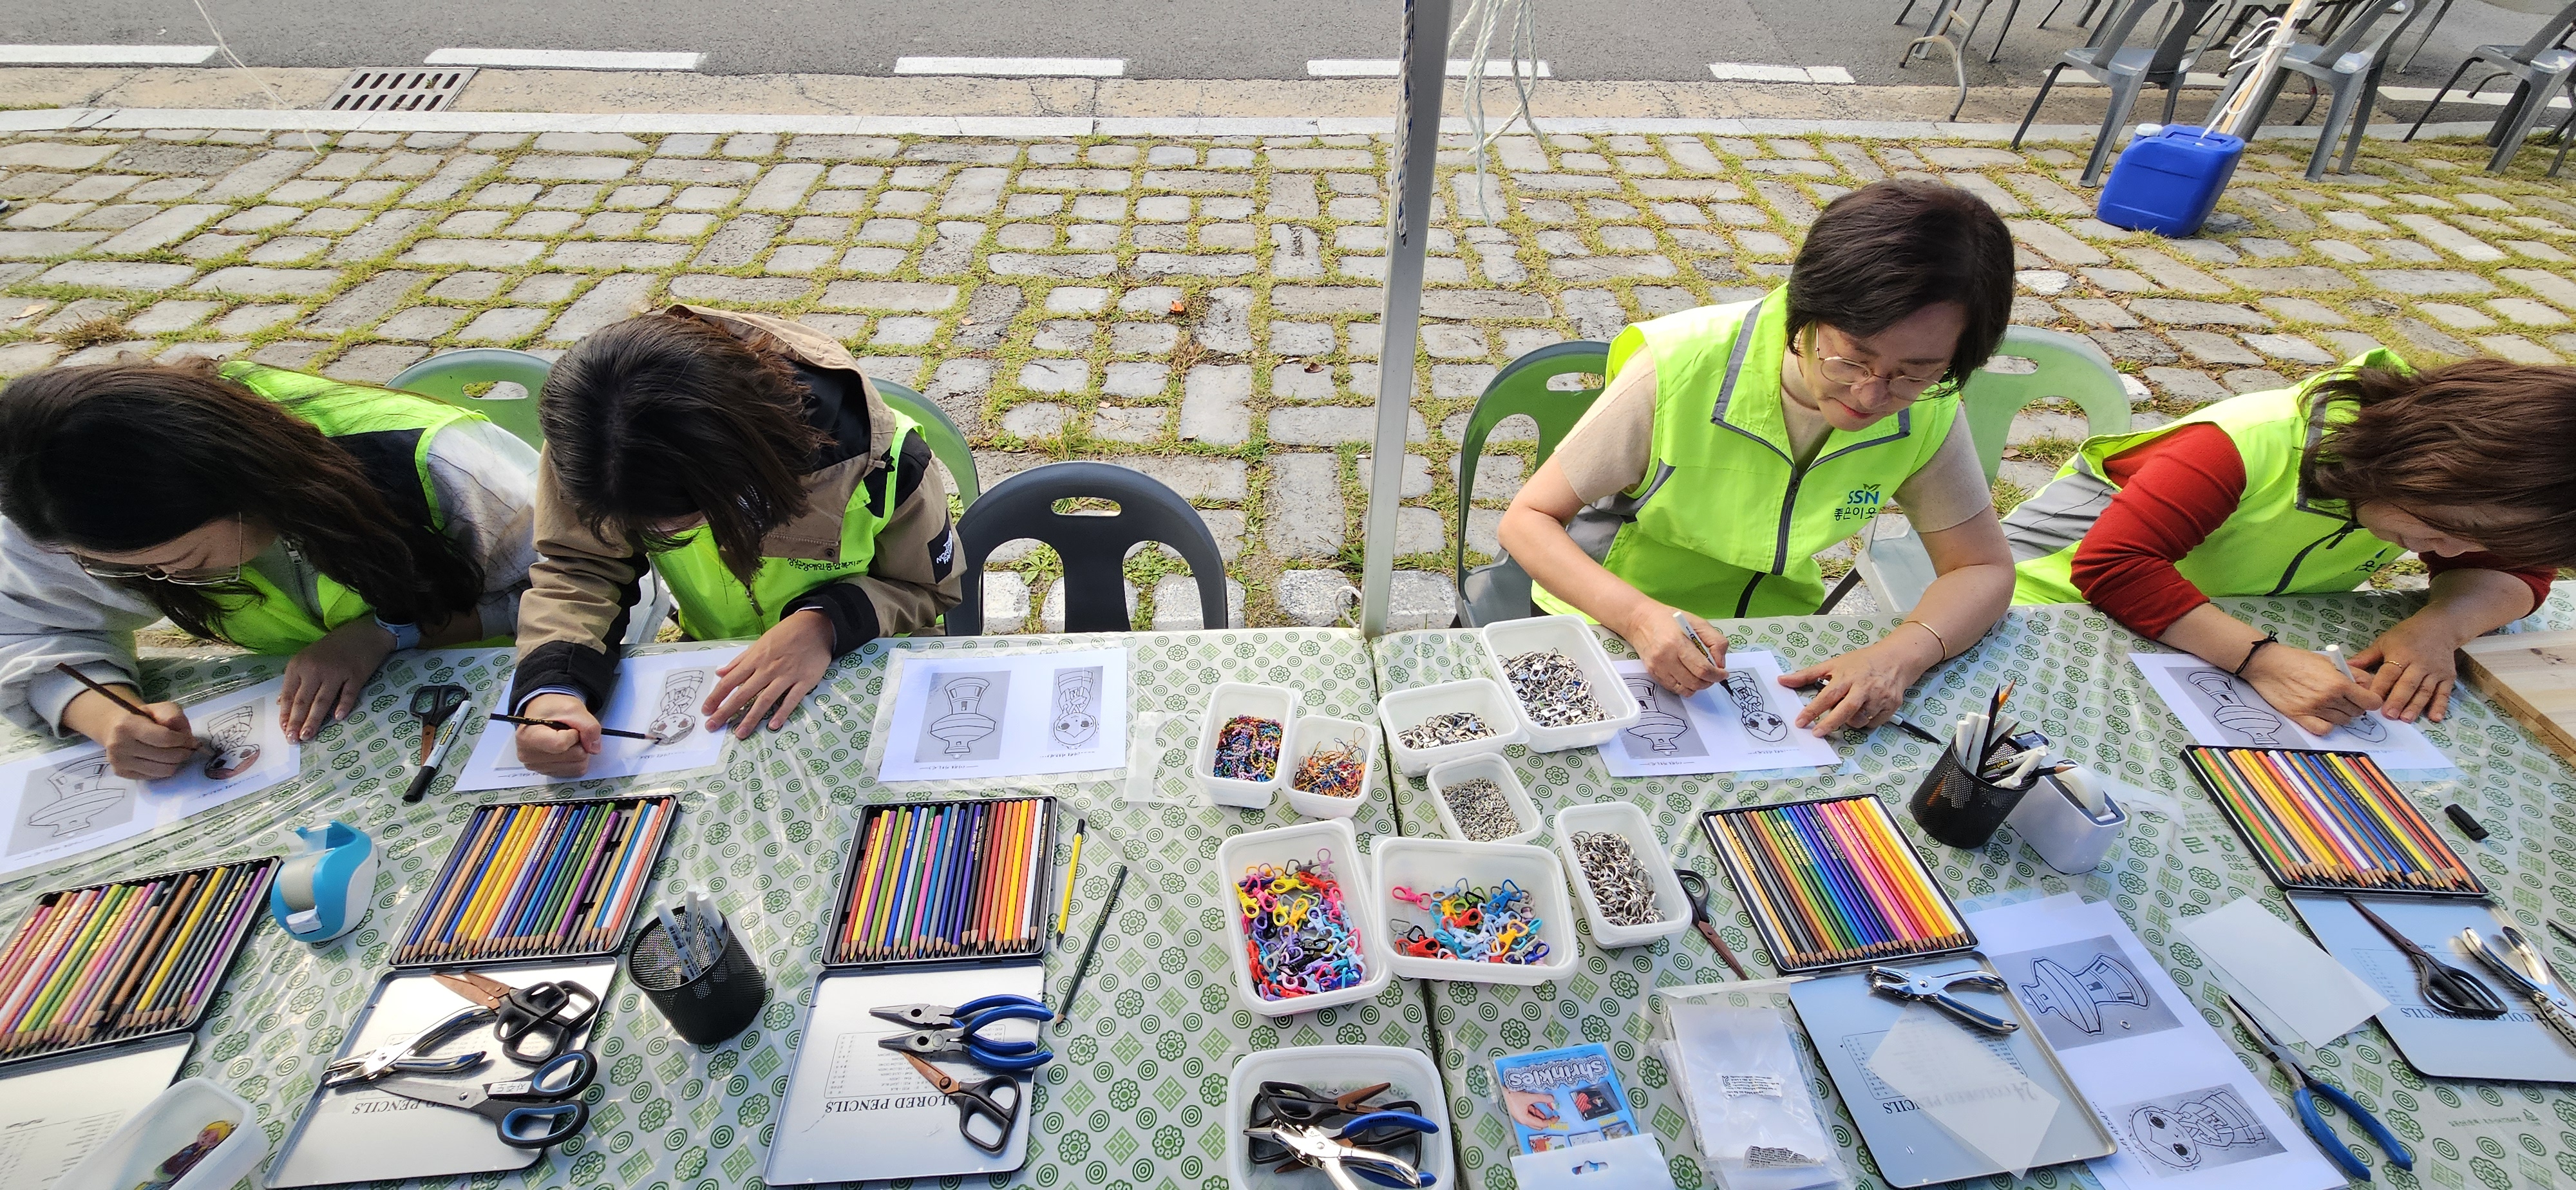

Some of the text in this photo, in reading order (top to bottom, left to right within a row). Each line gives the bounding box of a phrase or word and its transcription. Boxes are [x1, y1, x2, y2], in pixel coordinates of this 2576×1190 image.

[1847, 490, 1879, 504] SSN
[1099, 906, 1110, 925] COLORED
[1508, 1060, 1604, 1087] shrinkles
[351, 1099, 421, 1114] PENCILS
[825, 1095, 954, 1113] OLORED PENCILS
